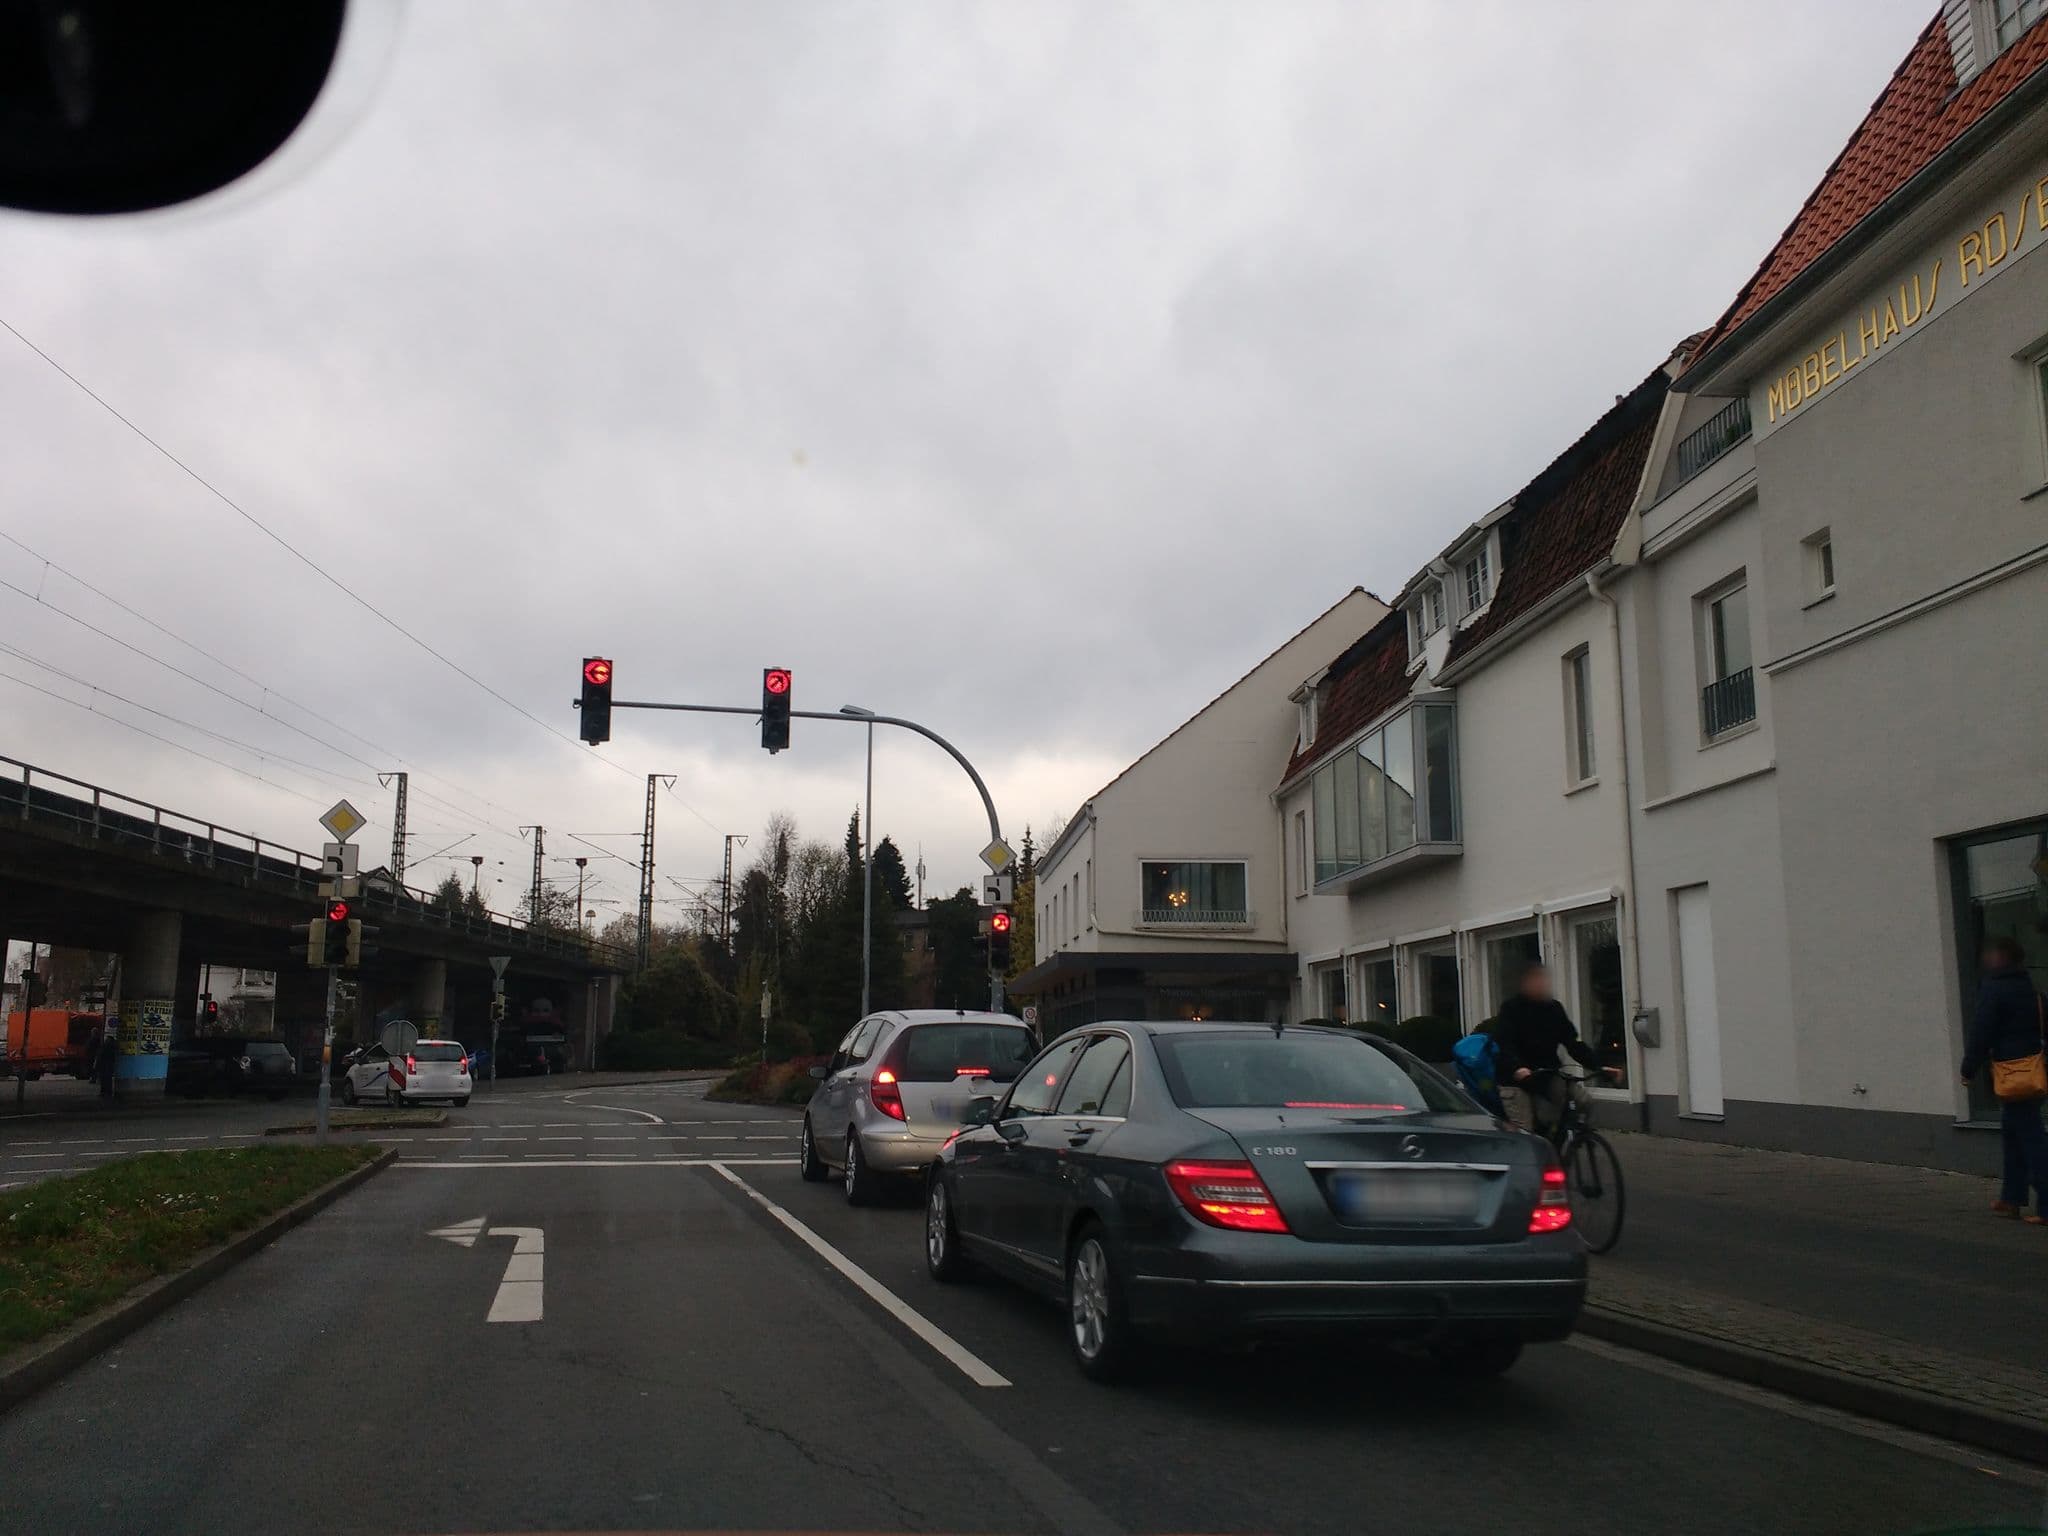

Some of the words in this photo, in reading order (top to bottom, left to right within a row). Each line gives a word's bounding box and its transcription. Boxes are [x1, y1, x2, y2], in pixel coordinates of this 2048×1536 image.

[1768, 259, 1942, 423] MÖBELHAUS
[1252, 1146, 1262, 1156] C
[1267, 1146, 1297, 1156] 180
